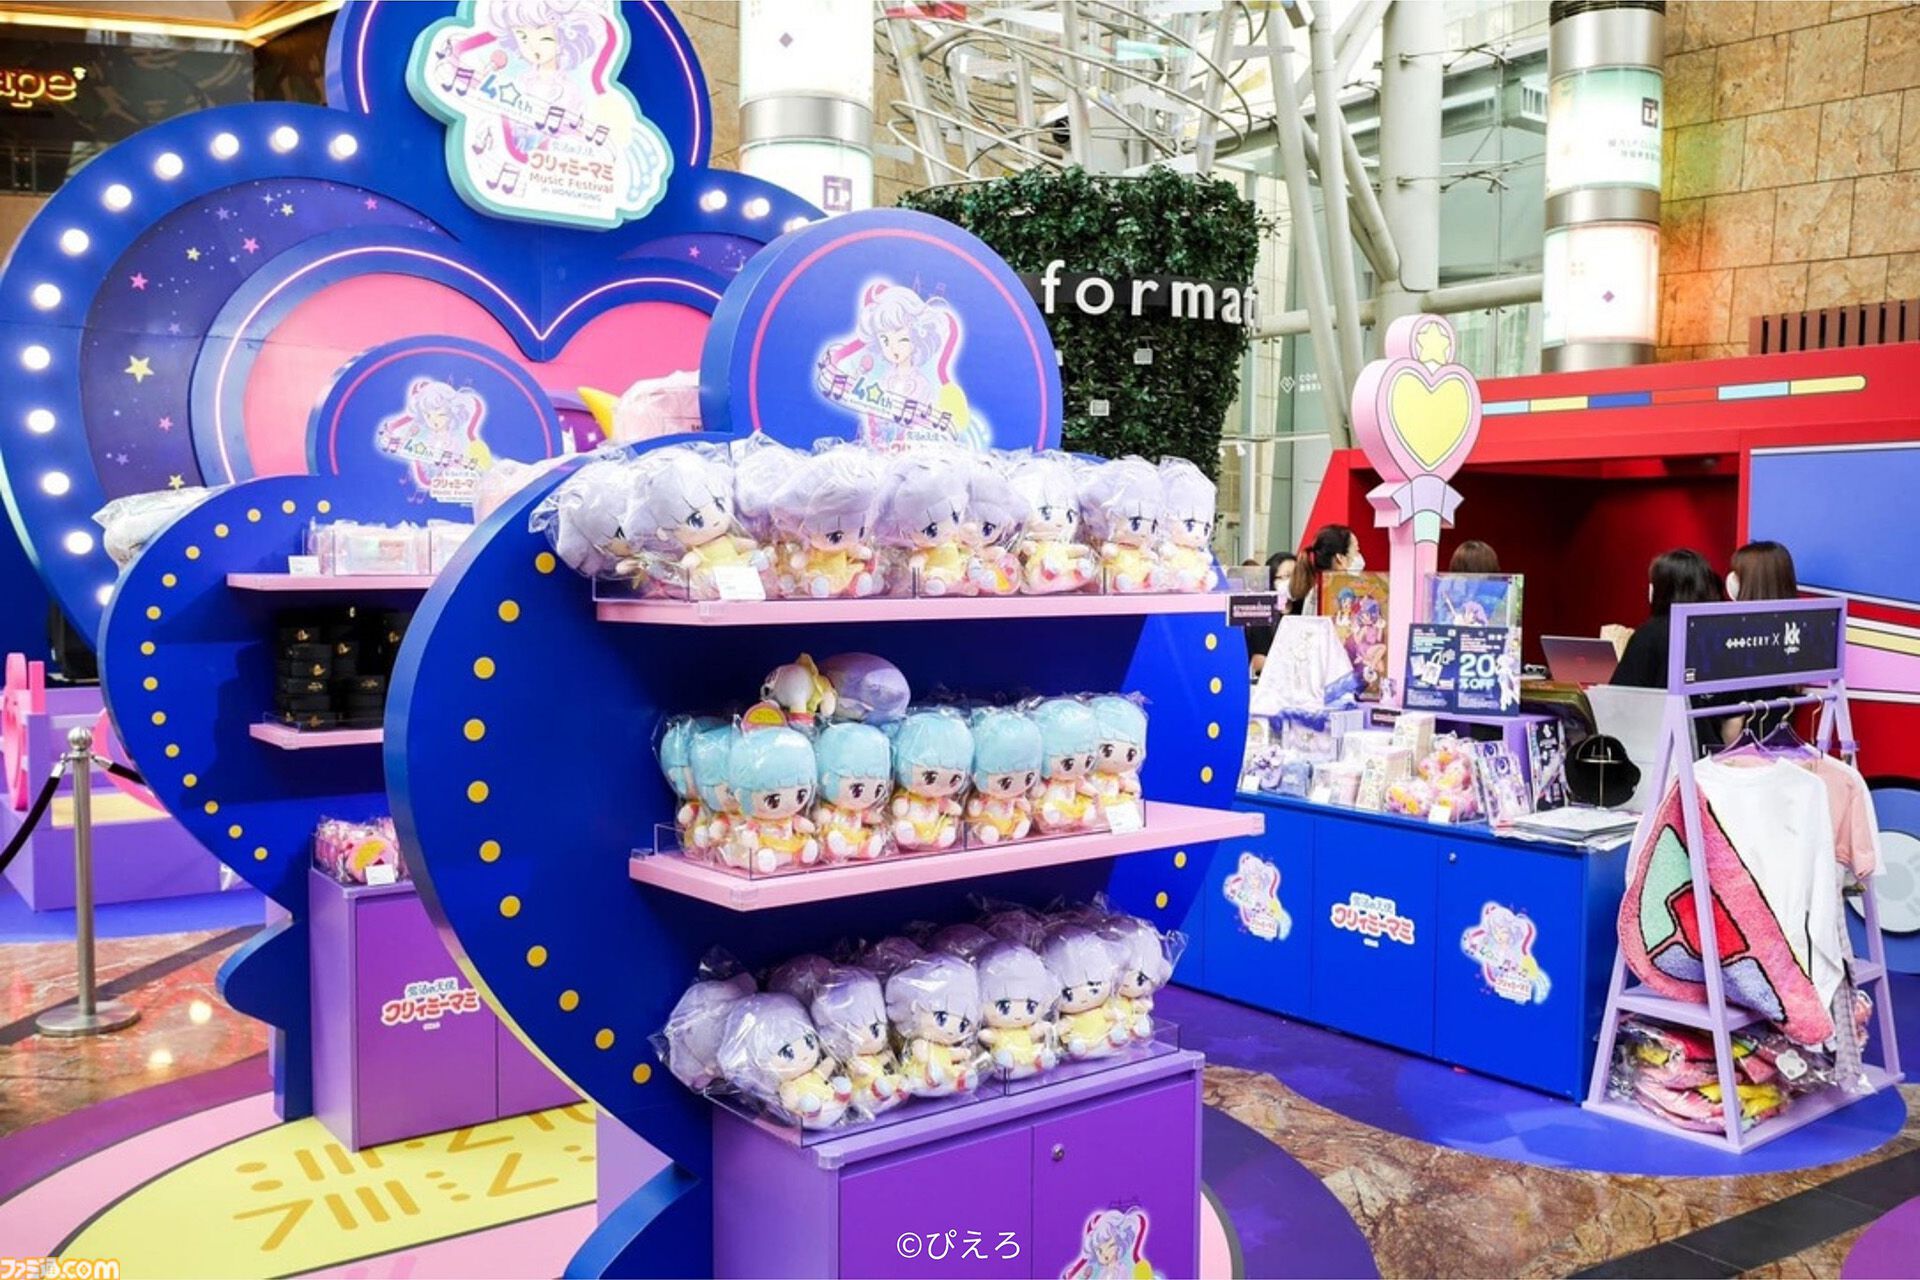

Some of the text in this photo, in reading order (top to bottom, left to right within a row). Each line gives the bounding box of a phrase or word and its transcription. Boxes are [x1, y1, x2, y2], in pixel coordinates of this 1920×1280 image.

[529, 172, 615, 194] Music Festival
[1459, 653, 1496, 678] 20
